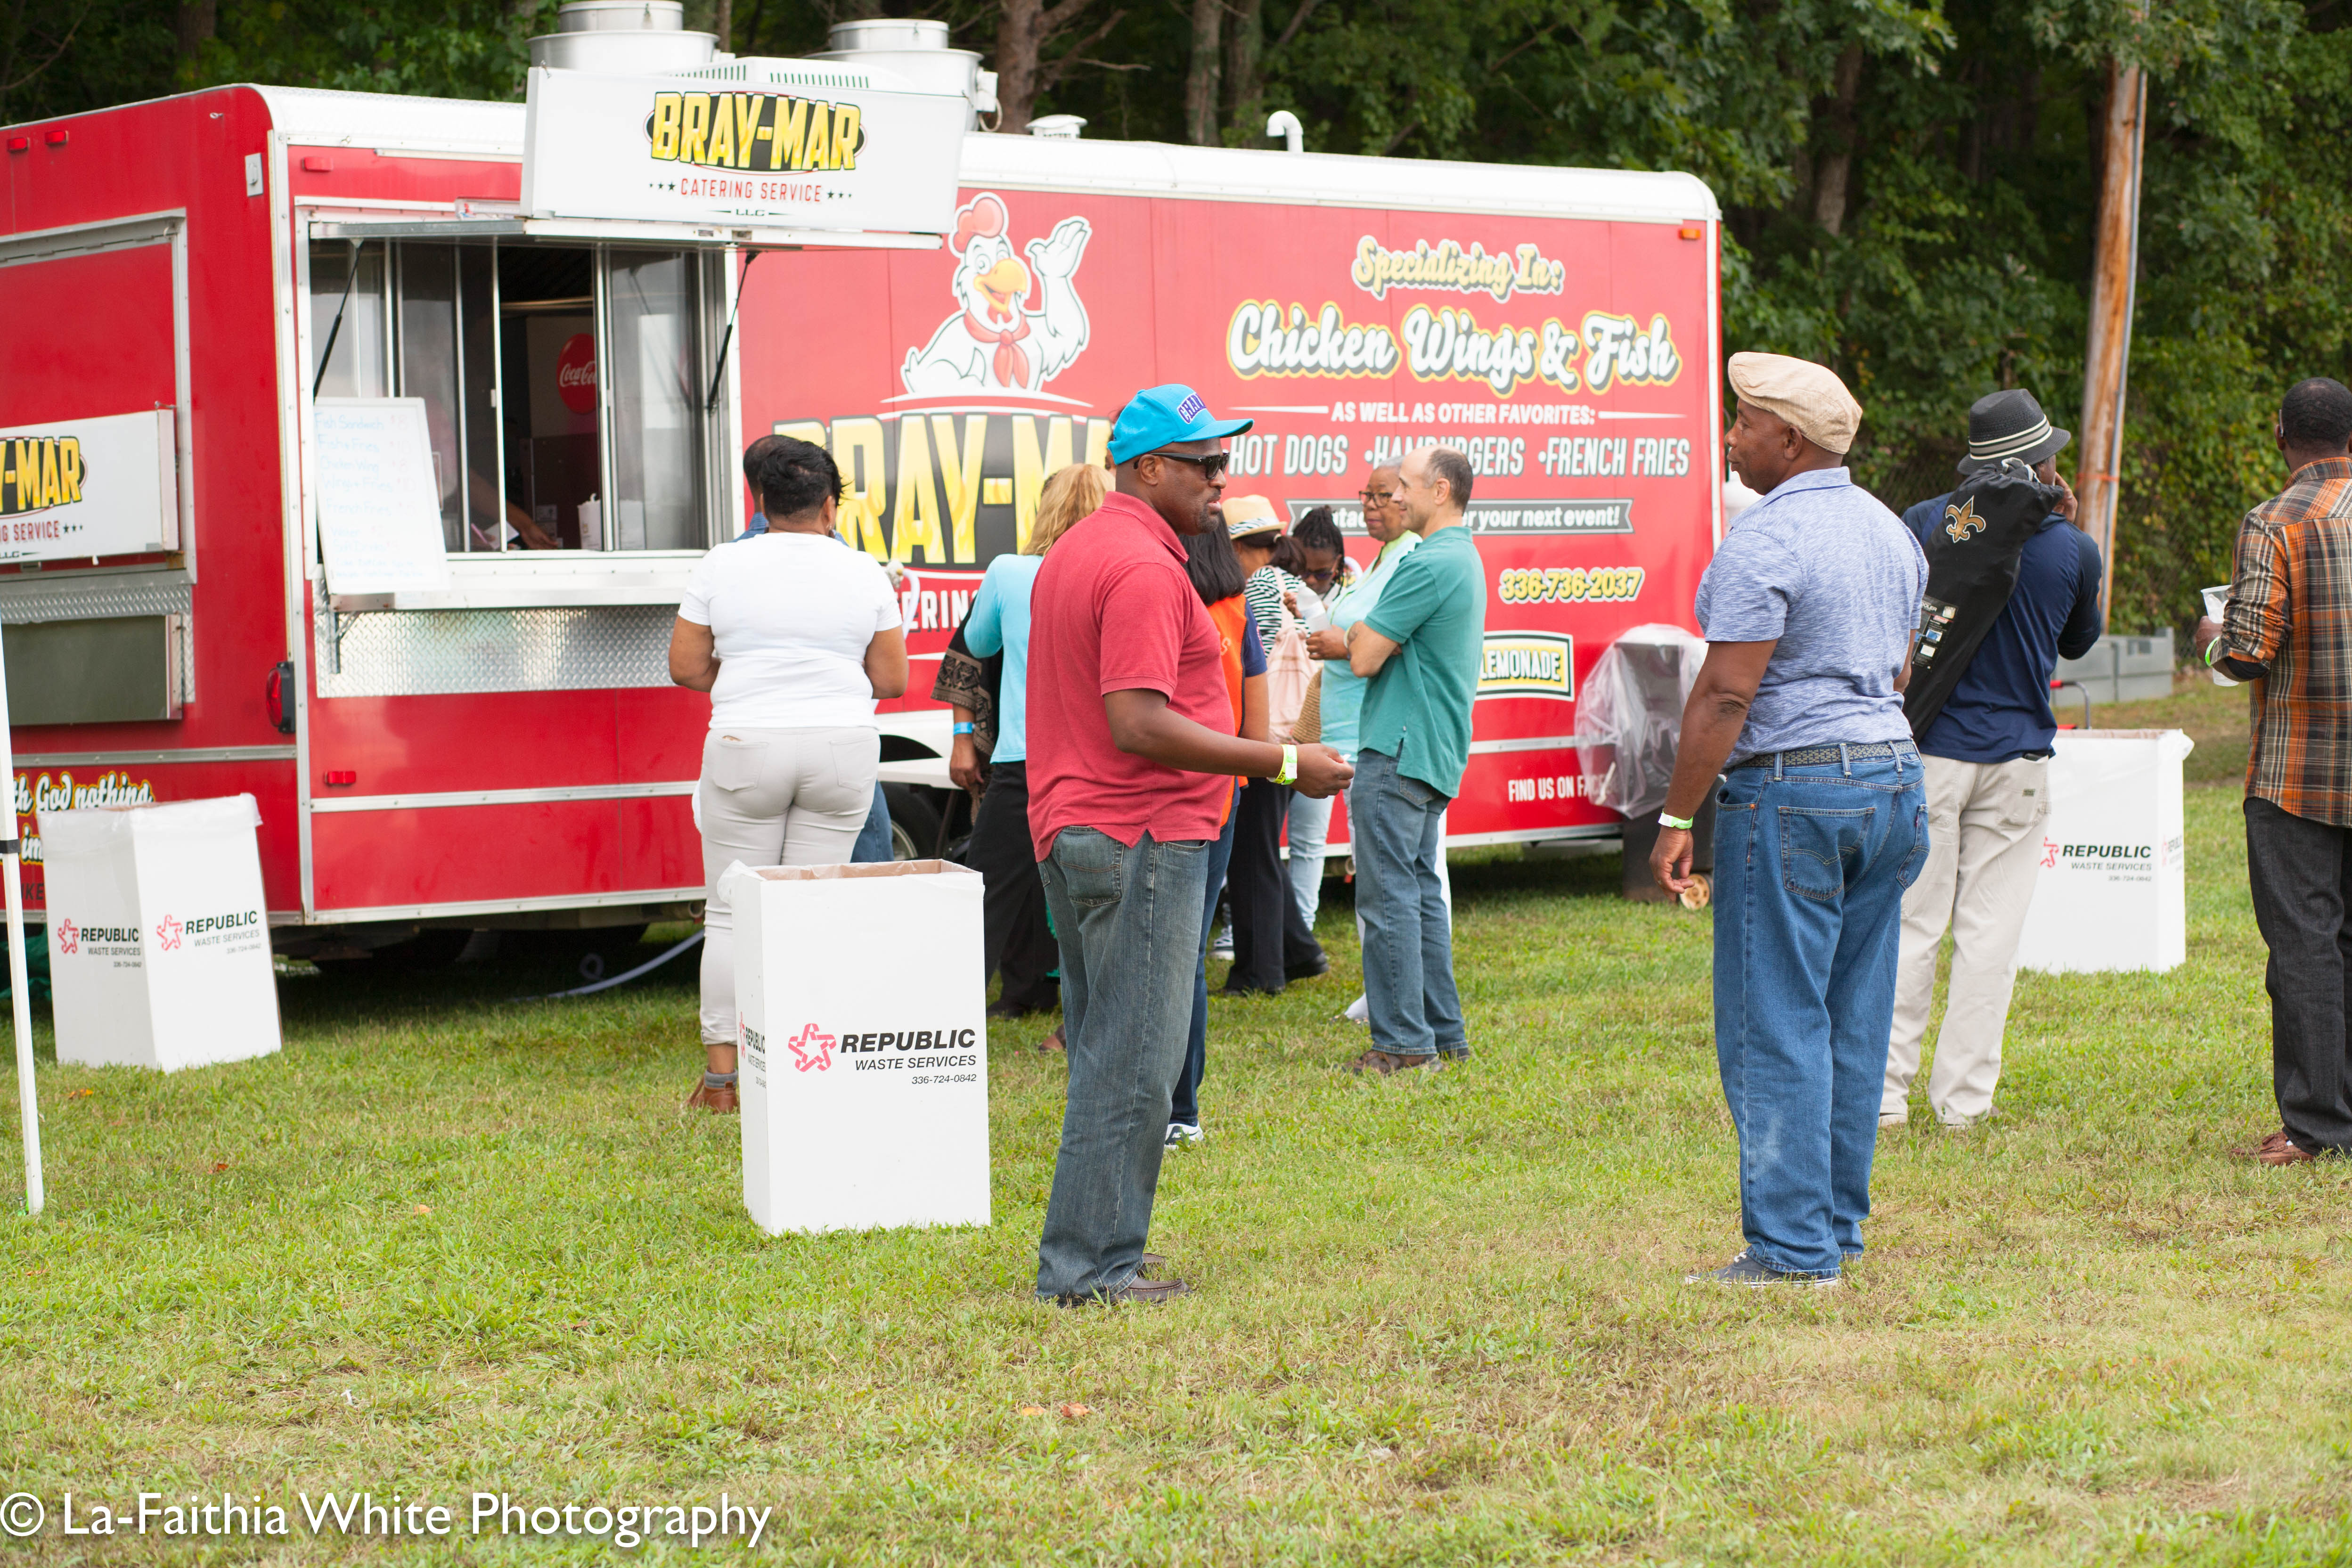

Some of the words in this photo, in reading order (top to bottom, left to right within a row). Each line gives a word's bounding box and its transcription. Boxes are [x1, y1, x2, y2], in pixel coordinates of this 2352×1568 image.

[651, 92, 860, 171] BRAY-MAR
[681, 178, 752, 199] CATERING
[761, 182, 822, 202] SERVICE
[1355, 239, 1513, 298] Specializing
[1516, 247, 1562, 291] In:
[1230, 303, 1398, 370] Chicken
[1405, 308, 1535, 390] Wings
[1540, 322, 1579, 387] &
[1584, 314, 1678, 388] Fish
[1331, 401, 1356, 422] AS
[1359, 402, 1409, 423] WELL
[1411, 403, 1435, 423] AS
[1438, 403, 1496, 424] OTHER
[1499, 404, 1595, 425] FAVORITES:
[1228, 434, 1278, 476] HOT
[1284, 434, 1348, 476] DOGS
[1545, 437, 1627, 476] FRENCH
[1632, 438, 1690, 477] FRIES
[14, 520, 59, 541] SERVICE
[1478, 510, 1521, 532] your
[1522, 506, 1562, 527] next
[1563, 506, 1620, 526] event!
[1501, 570, 1642, 600] 336-736-2037
[1480, 649, 1561, 681] LEMONADE
[35, 774, 72, 811] God
[1508, 779, 1535, 802] FIND
[1538, 777, 1554, 799] US
[1557, 776, 1575, 798] ON
[2062, 845, 2151, 858] REPUBLIC
[2071, 862, 2103, 871] WASTE
[2106, 862, 2152, 872] SERVICES
[81, 927, 139, 942] REPUBLIC
[186, 910, 257, 935] REPUBLIC
[194, 935, 220, 947] WASTE
[223, 929, 260, 943] SERVICES
[88, 947, 109, 956] WASTE
[111, 947, 140, 956] SERVICES
[746, 1026, 765, 1054] REPUBLIC
[841, 1029, 975, 1054] REPUBLIC
[855, 1058, 903, 1071] WASTE
[907, 1055, 976, 1069] SERVICES
[912, 1074, 976, 1085] 336-724-0842
